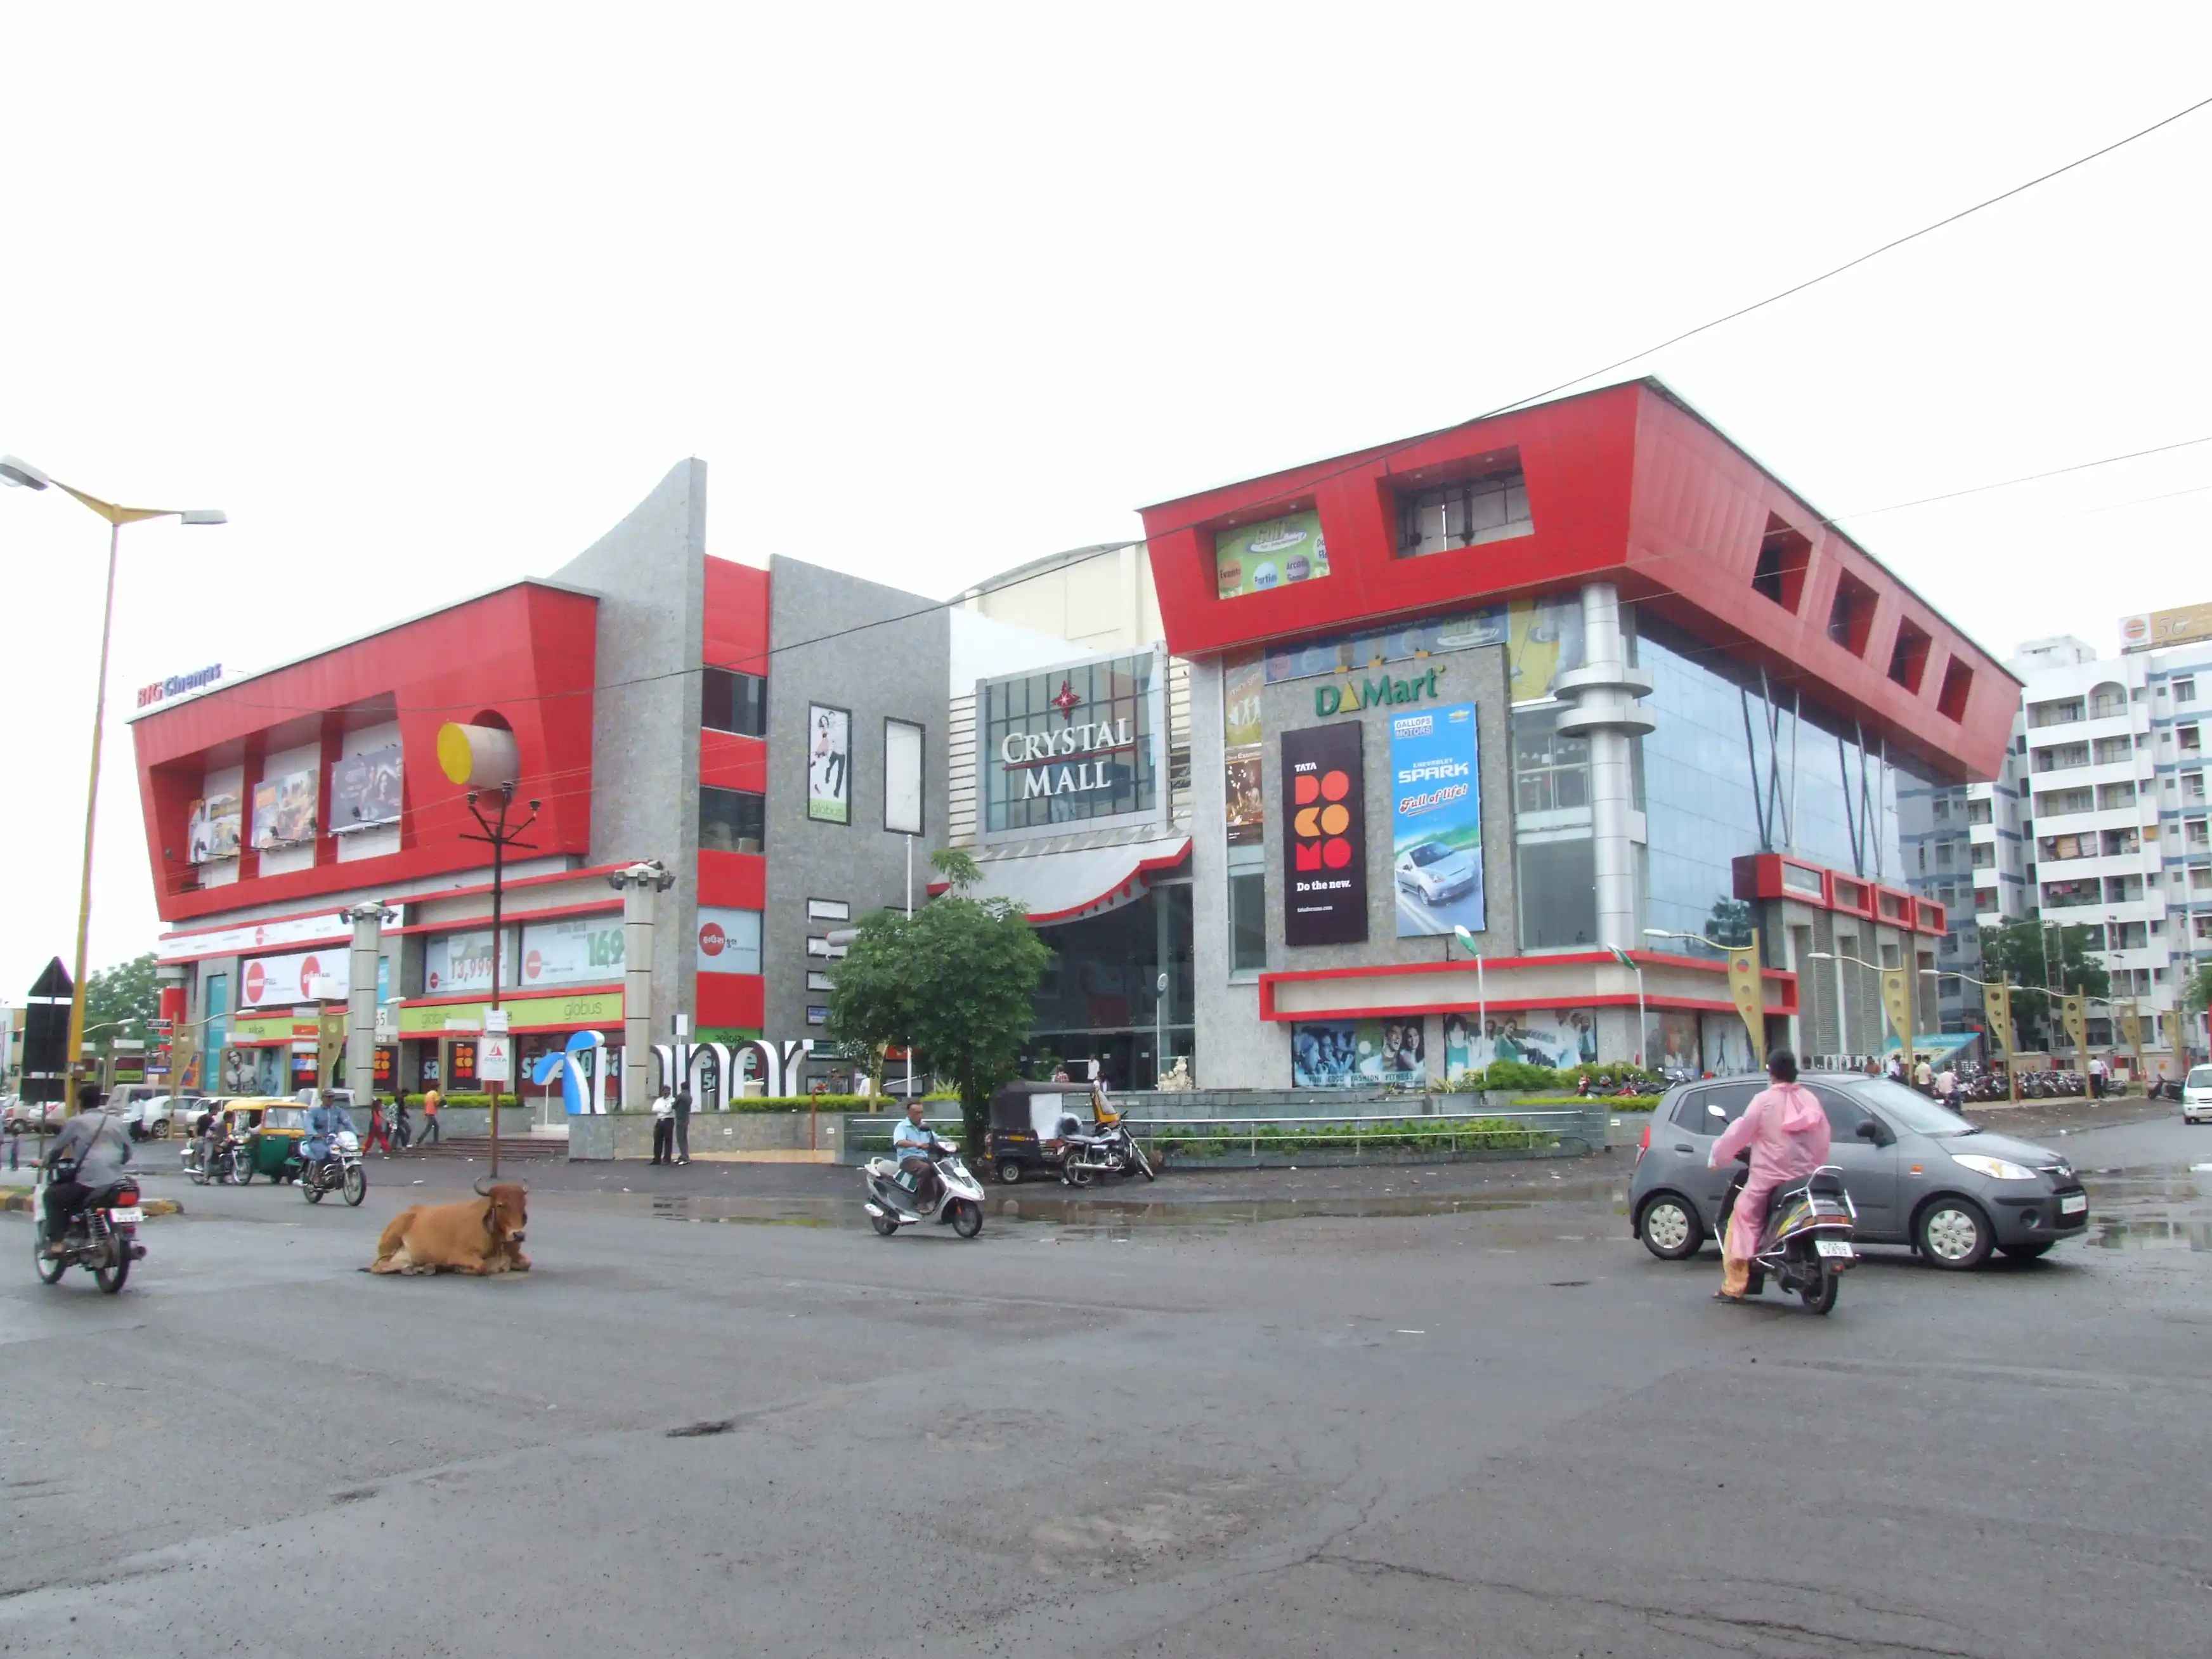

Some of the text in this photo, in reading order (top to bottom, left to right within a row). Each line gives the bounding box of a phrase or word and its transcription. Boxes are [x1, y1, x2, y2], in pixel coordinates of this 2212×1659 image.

[137, 663, 221, 708] BIG Cinemas
[1396, 717, 1431, 729] GALLOPS
[1396, 726, 1432, 738] MOTORS
[1002, 718, 1134, 764] CRYSTAL
[1295, 762, 1317, 772] TATA
[1398, 762, 1469, 784] SPARK
[1022, 761, 1111, 800] MALL
[1400, 783, 1469, 814] Full of life!
[1296, 880, 1351, 892] Do the new.
[564, 999, 602, 1020] globus
